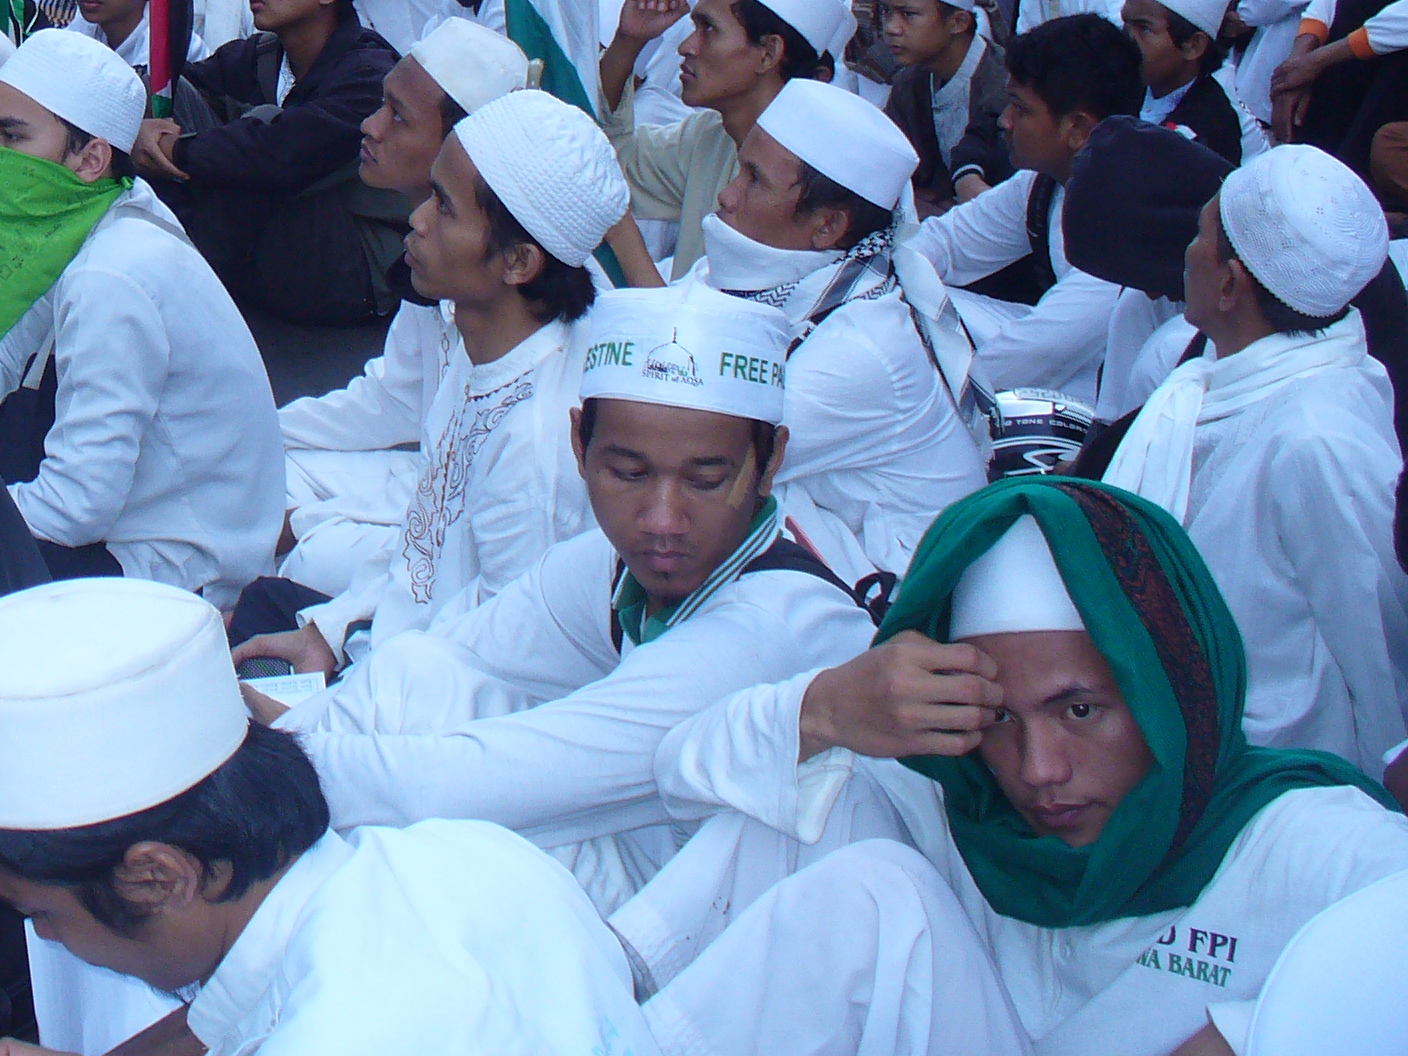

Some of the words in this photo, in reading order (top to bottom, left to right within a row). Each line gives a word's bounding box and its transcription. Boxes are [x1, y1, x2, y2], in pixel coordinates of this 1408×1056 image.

[719, 352, 768, 384] FREE
[1188, 927, 1238, 962] FPI
[1168, 952, 1232, 987] BARAT
